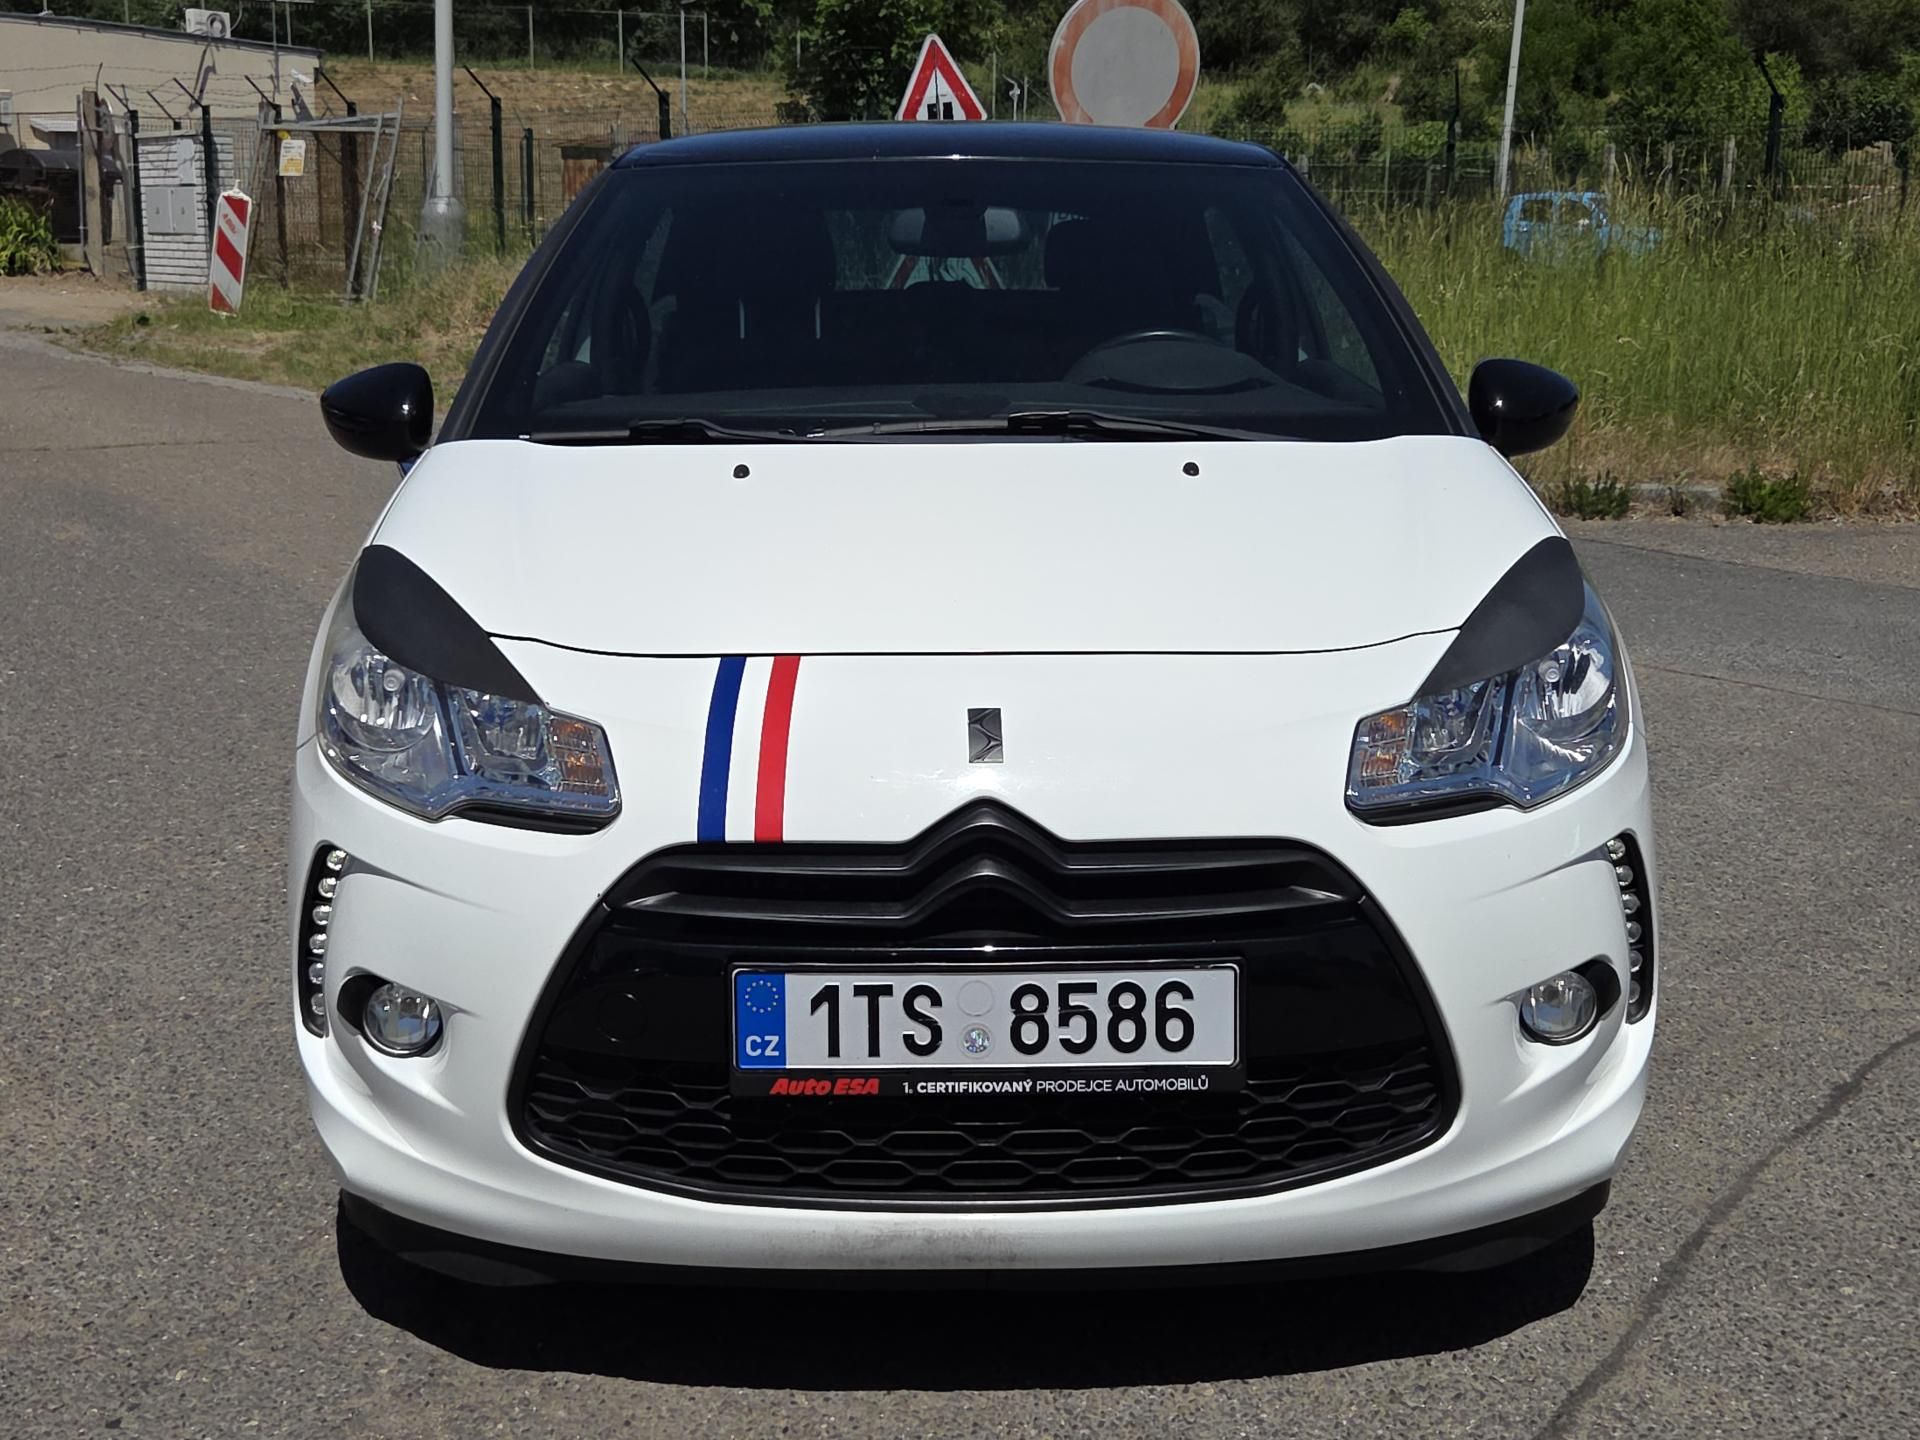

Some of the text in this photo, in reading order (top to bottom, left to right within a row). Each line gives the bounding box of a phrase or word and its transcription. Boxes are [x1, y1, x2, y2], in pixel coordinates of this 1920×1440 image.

[810, 980, 1195, 1058] 1TS 8586
[745, 1035, 780, 1057] CZ
[769, 1078, 880, 1096] Auto ESA
[902, 1074, 1209, 1094] 1. CERTIFIKOVANÝ PRODEJCE AUTOMOBILŮ
